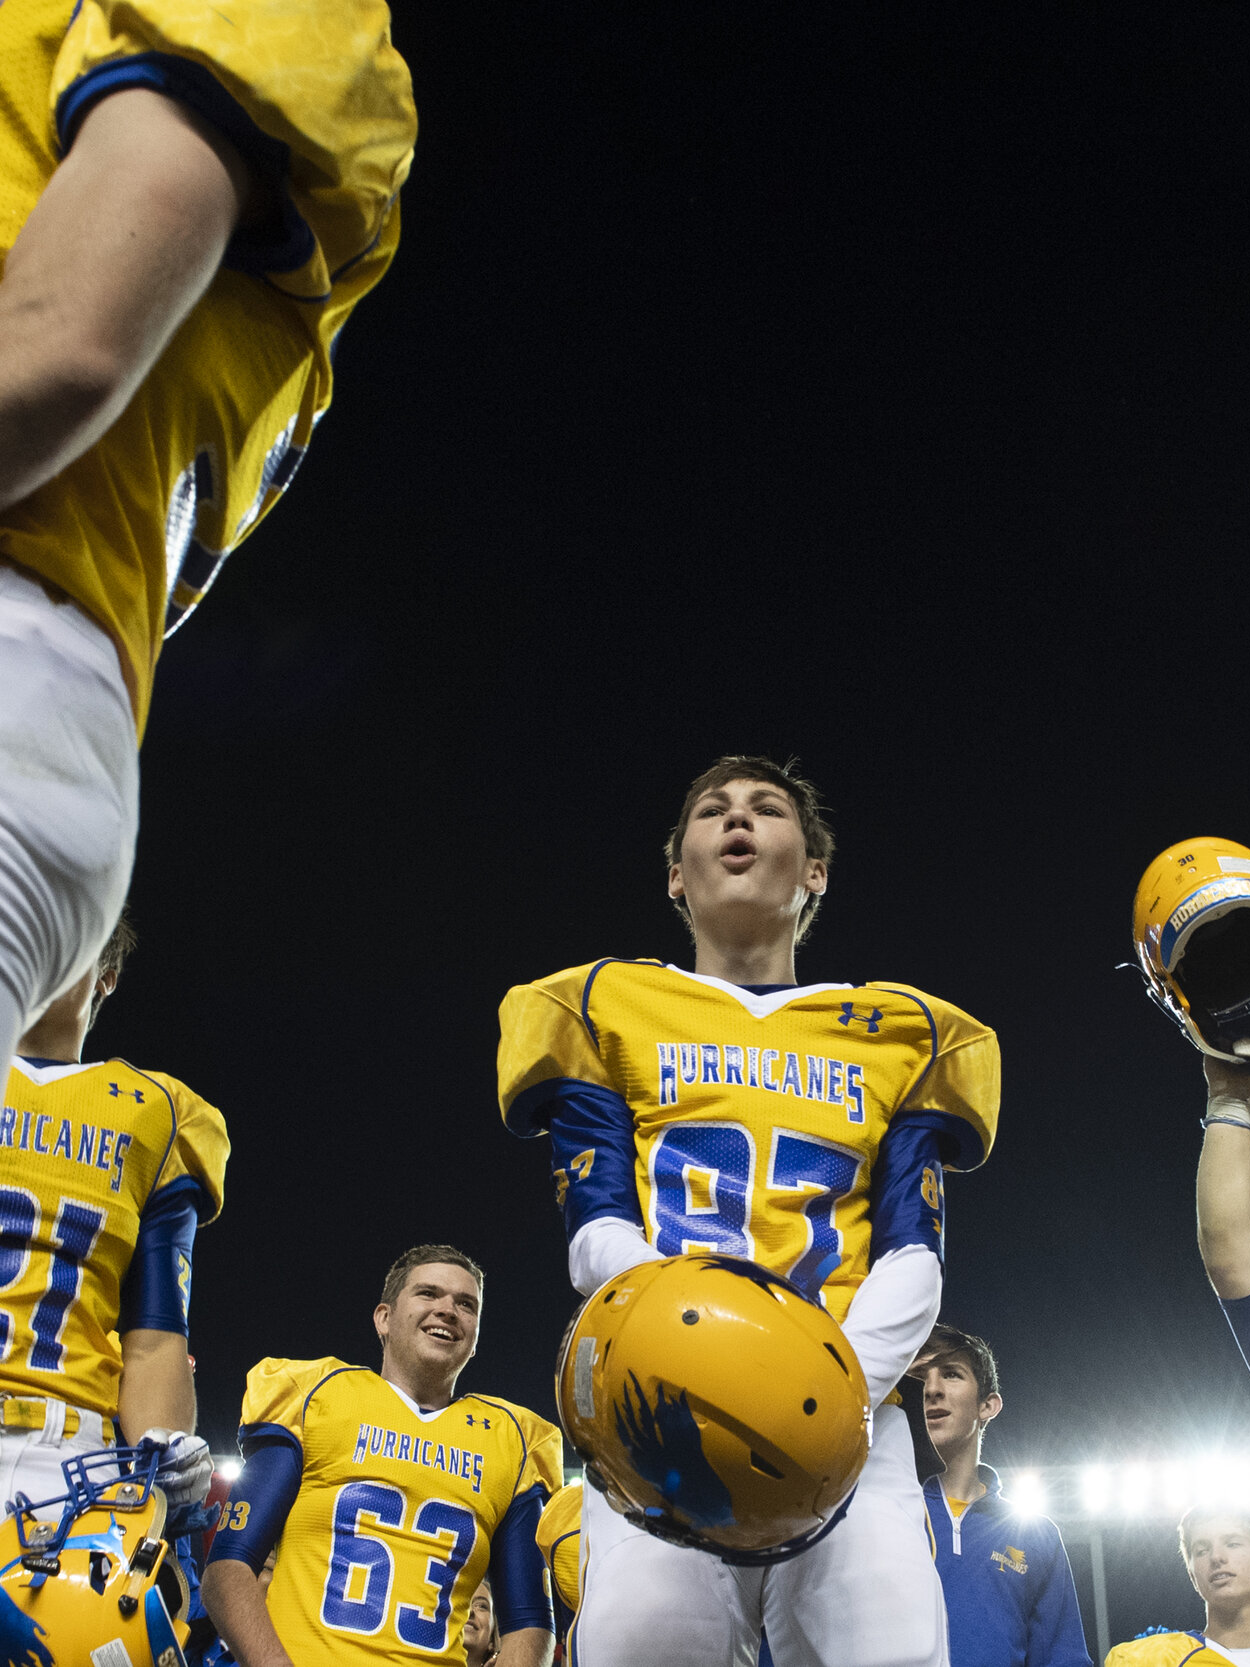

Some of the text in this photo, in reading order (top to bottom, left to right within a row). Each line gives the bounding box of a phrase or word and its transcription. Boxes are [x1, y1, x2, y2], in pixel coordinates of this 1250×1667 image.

[1178, 854, 1195, 866] 30
[656, 1042, 866, 1124] HURRICANES
[648, 1121, 866, 1308] 87
[352, 1424, 485, 1494] HURRICANES
[217, 1501, 251, 1532] 63
[320, 1481, 478, 1652] 63
